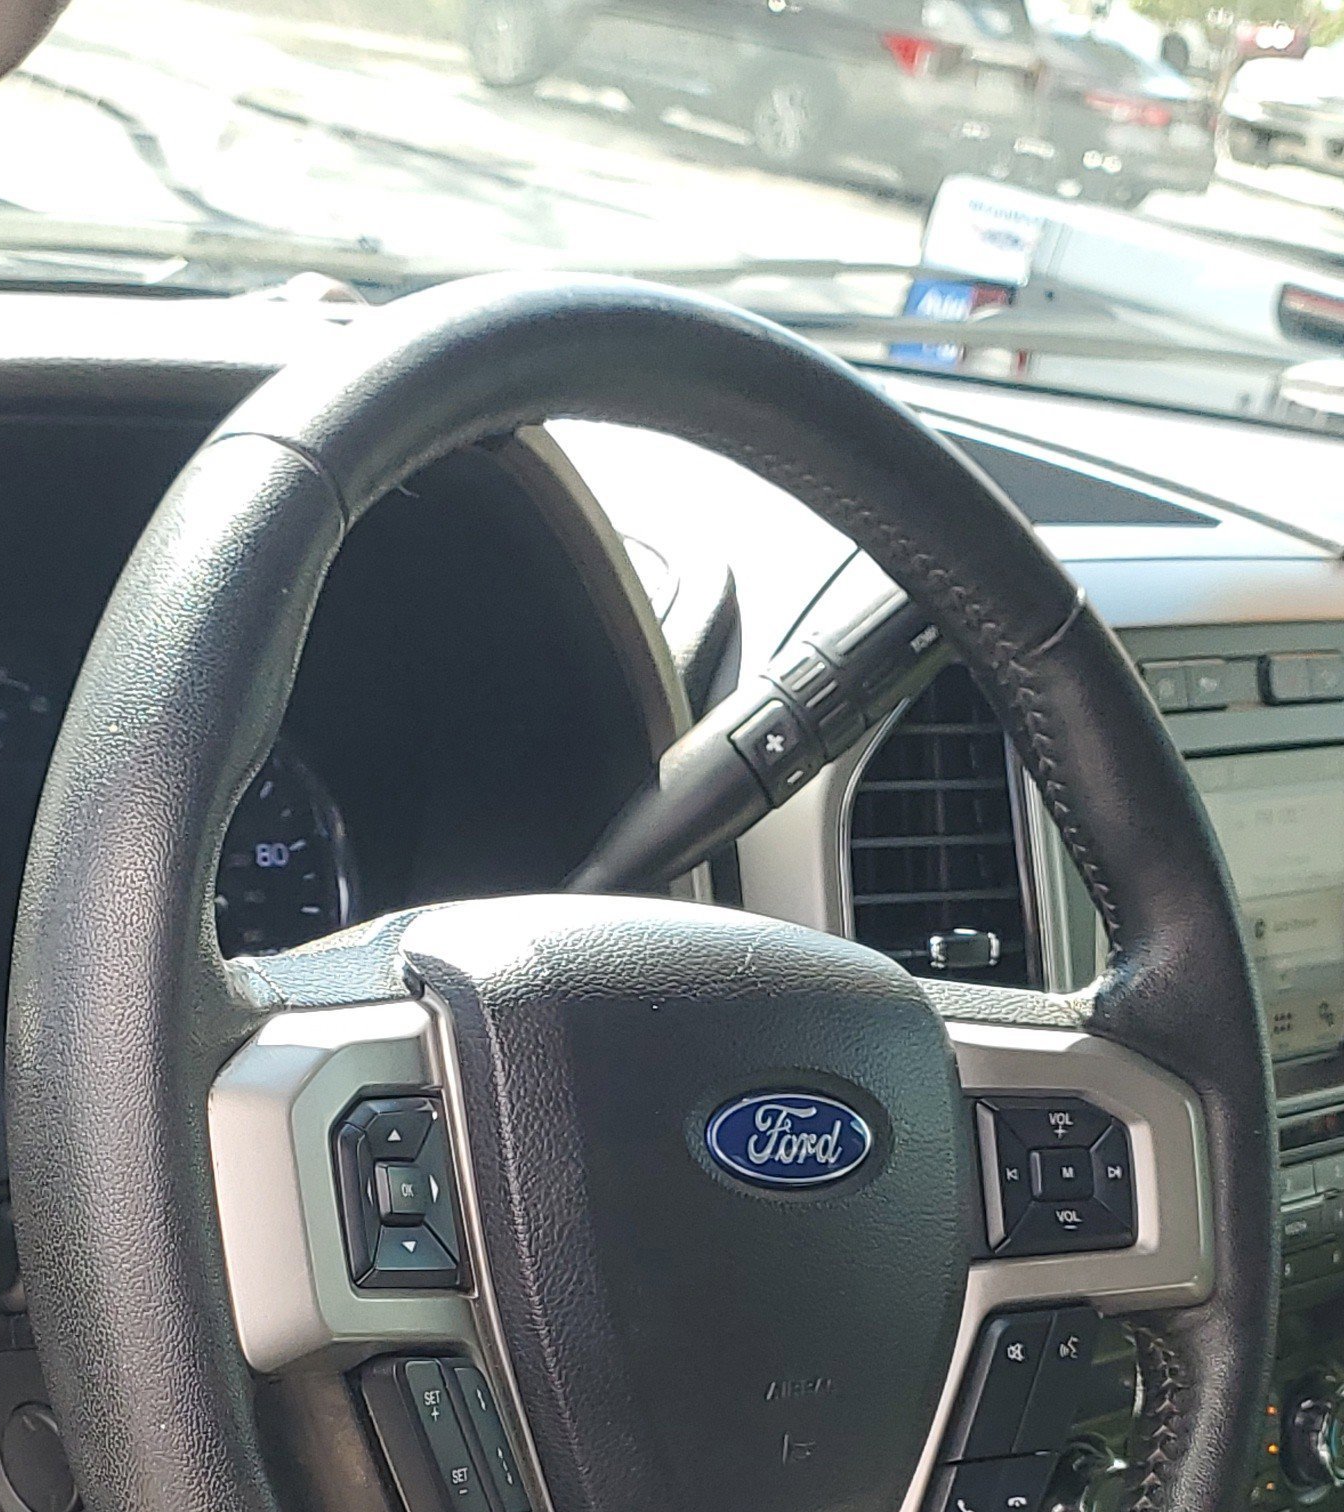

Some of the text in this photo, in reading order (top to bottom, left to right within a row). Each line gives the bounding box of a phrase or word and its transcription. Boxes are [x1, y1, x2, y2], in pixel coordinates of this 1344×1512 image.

[256, 842, 290, 868] 80
[1048, 1112, 1073, 1127] VOL
[747, 1102, 844, 1166] Ford
[400, 1182, 416, 1198] OK
[1056, 1210, 1081, 1224] VOL
[423, 1390, 441, 1406] SET
[451, 1467, 469, 1484] SET
